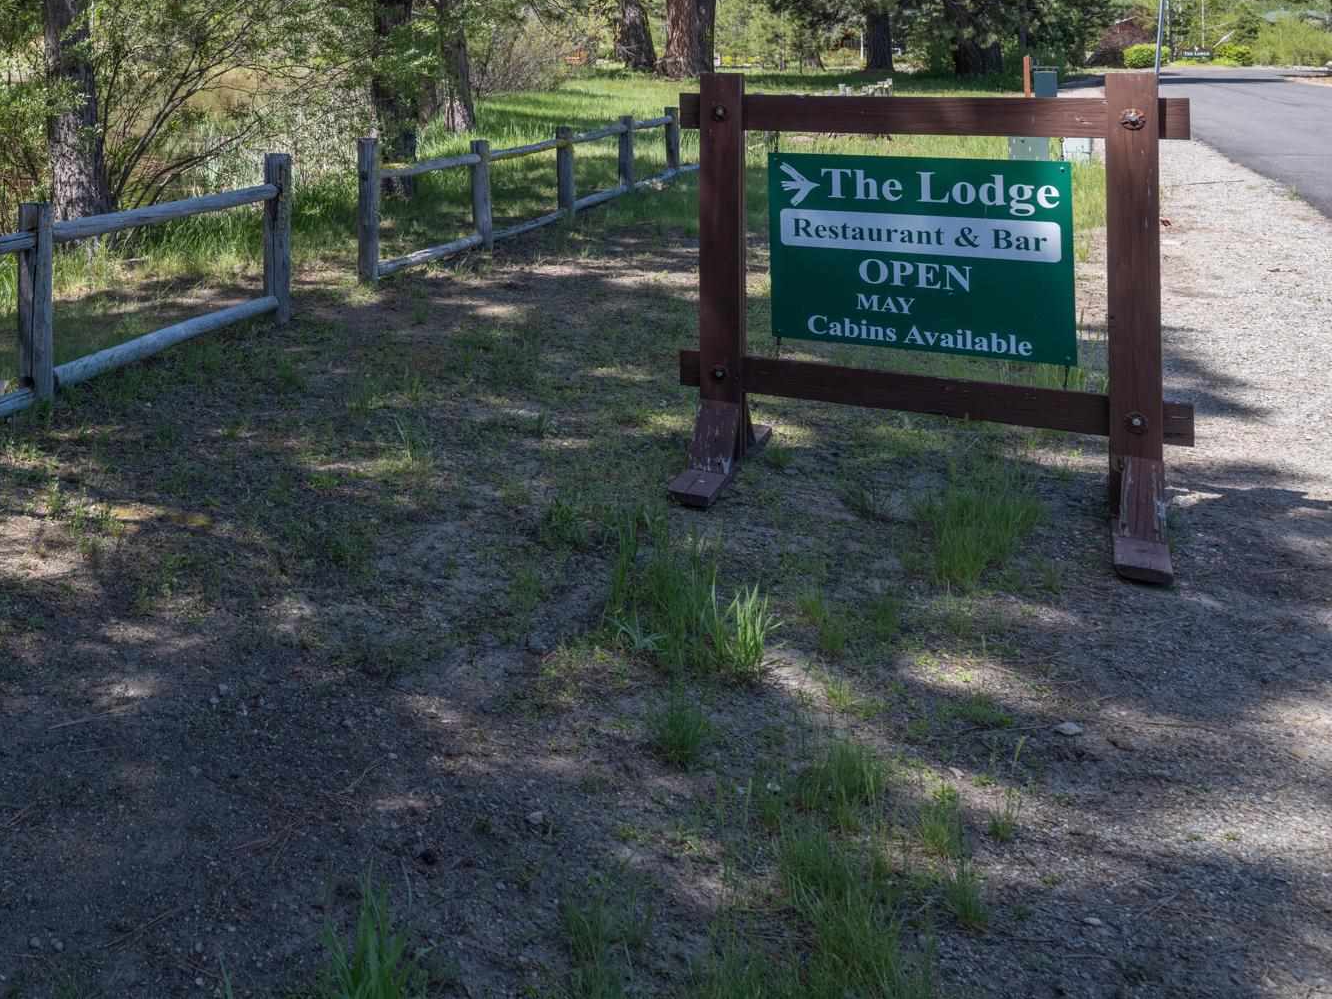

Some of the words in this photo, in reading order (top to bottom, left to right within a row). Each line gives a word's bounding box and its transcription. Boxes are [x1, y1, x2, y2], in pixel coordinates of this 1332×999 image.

[821, 168, 902, 201] The
[916, 172, 1060, 216] Lodge
[793, 218, 944, 246] Restaurant
[954, 227, 980, 248] &
[992, 229, 1048, 252] Bar
[858, 259, 973, 292] OPEN
[856, 293, 915, 314] MAY
[807, 315, 897, 342] Cabins
[905, 325, 1033, 356] Available
